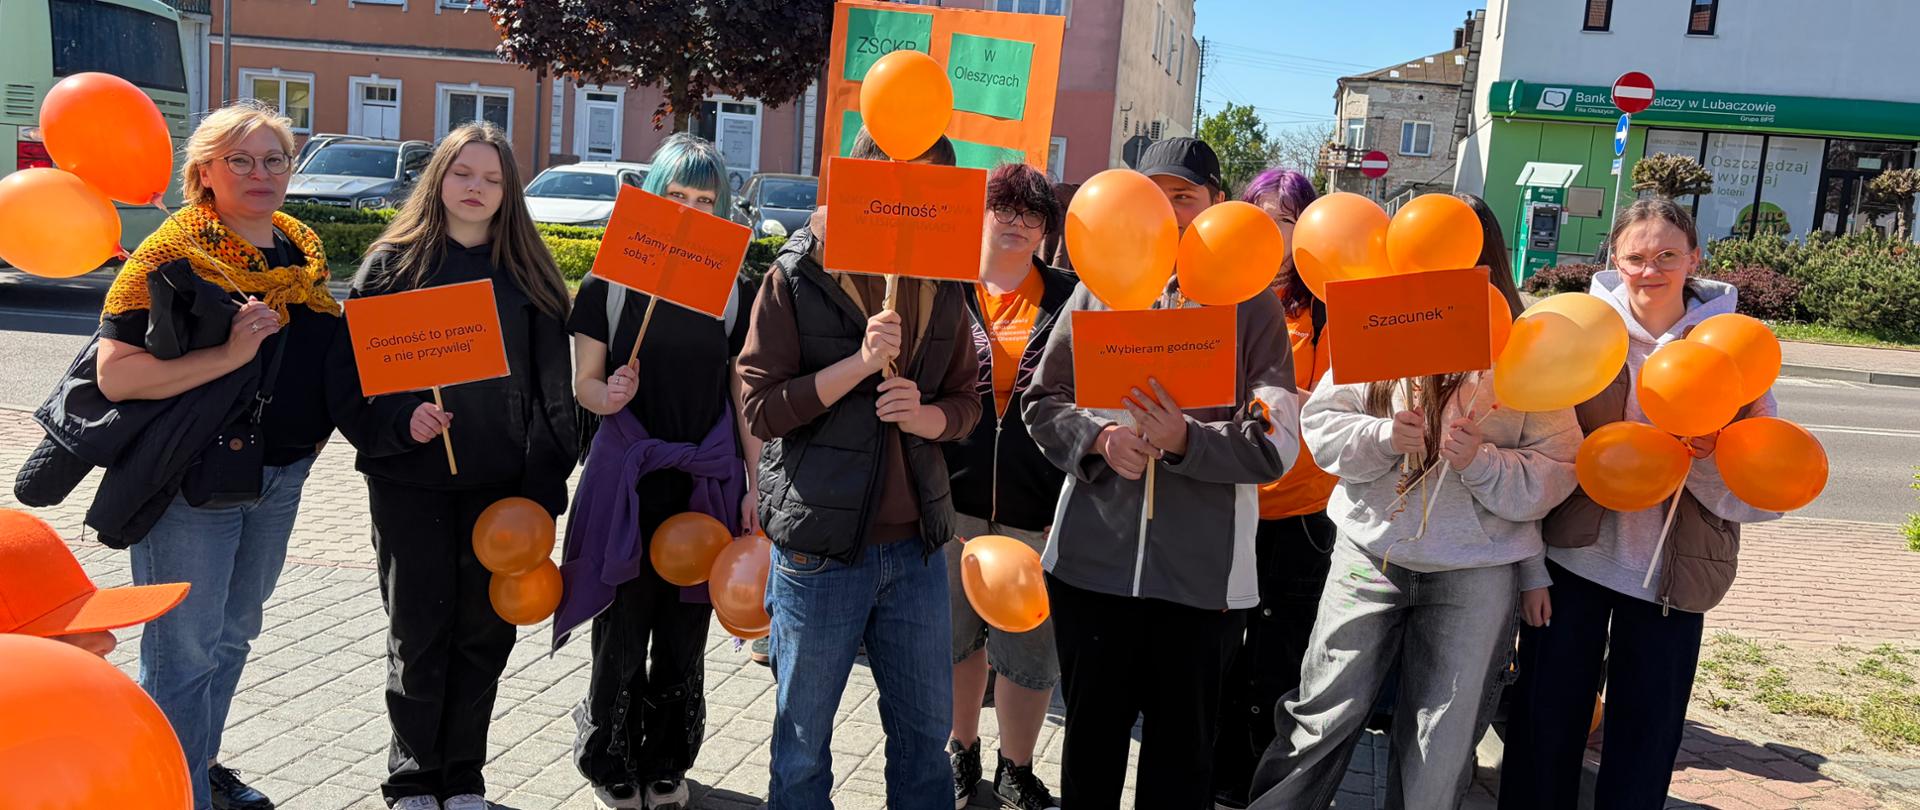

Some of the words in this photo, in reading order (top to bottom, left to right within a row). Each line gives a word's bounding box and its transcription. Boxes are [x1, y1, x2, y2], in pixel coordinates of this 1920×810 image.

[954, 66, 1019, 87] Oleszycach
[1576, 92, 1606, 104] Bank
[1688, 101, 1699, 109] w
[1702, 98, 1776, 112] Lubaczowie
[669, 245, 701, 262] prawo
[704, 255, 723, 270] być
[366, 330, 426, 350] „Godność
[429, 329, 442, 340] to
[445, 323, 487, 338] prawo,
[383, 355, 391, 363] a
[395, 349, 414, 361] nie
[1100, 343, 1164, 356] „Wybieram
